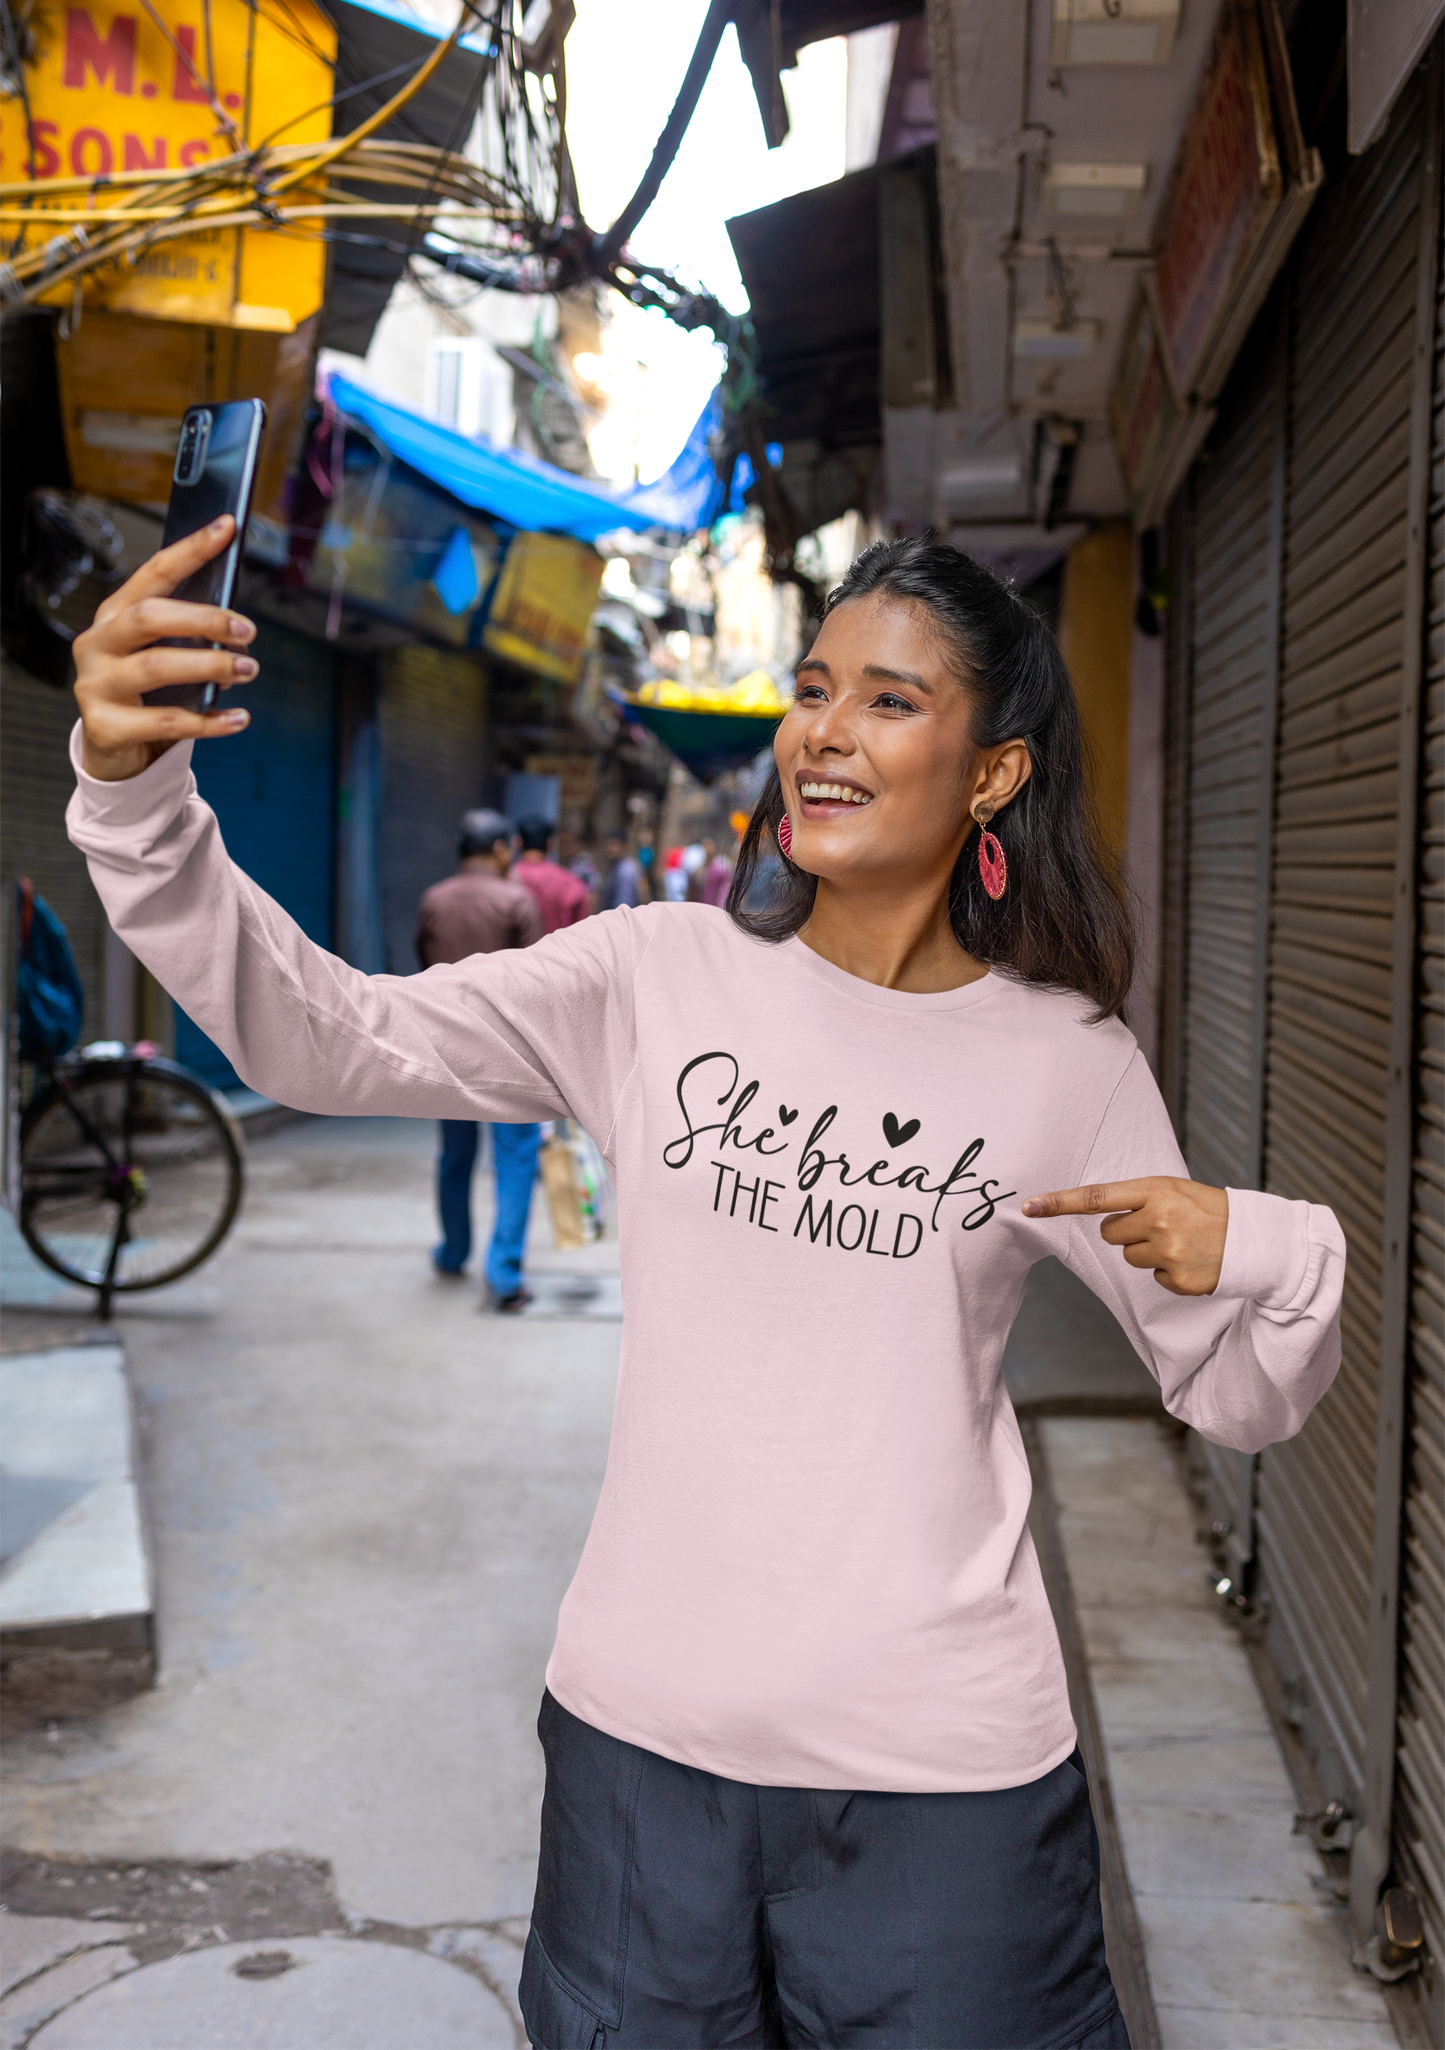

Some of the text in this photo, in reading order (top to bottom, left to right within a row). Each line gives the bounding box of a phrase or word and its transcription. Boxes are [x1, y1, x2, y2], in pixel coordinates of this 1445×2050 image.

[663, 1051, 1018, 1233] She breaks
[710, 1160, 924, 1259] THE MOLD
